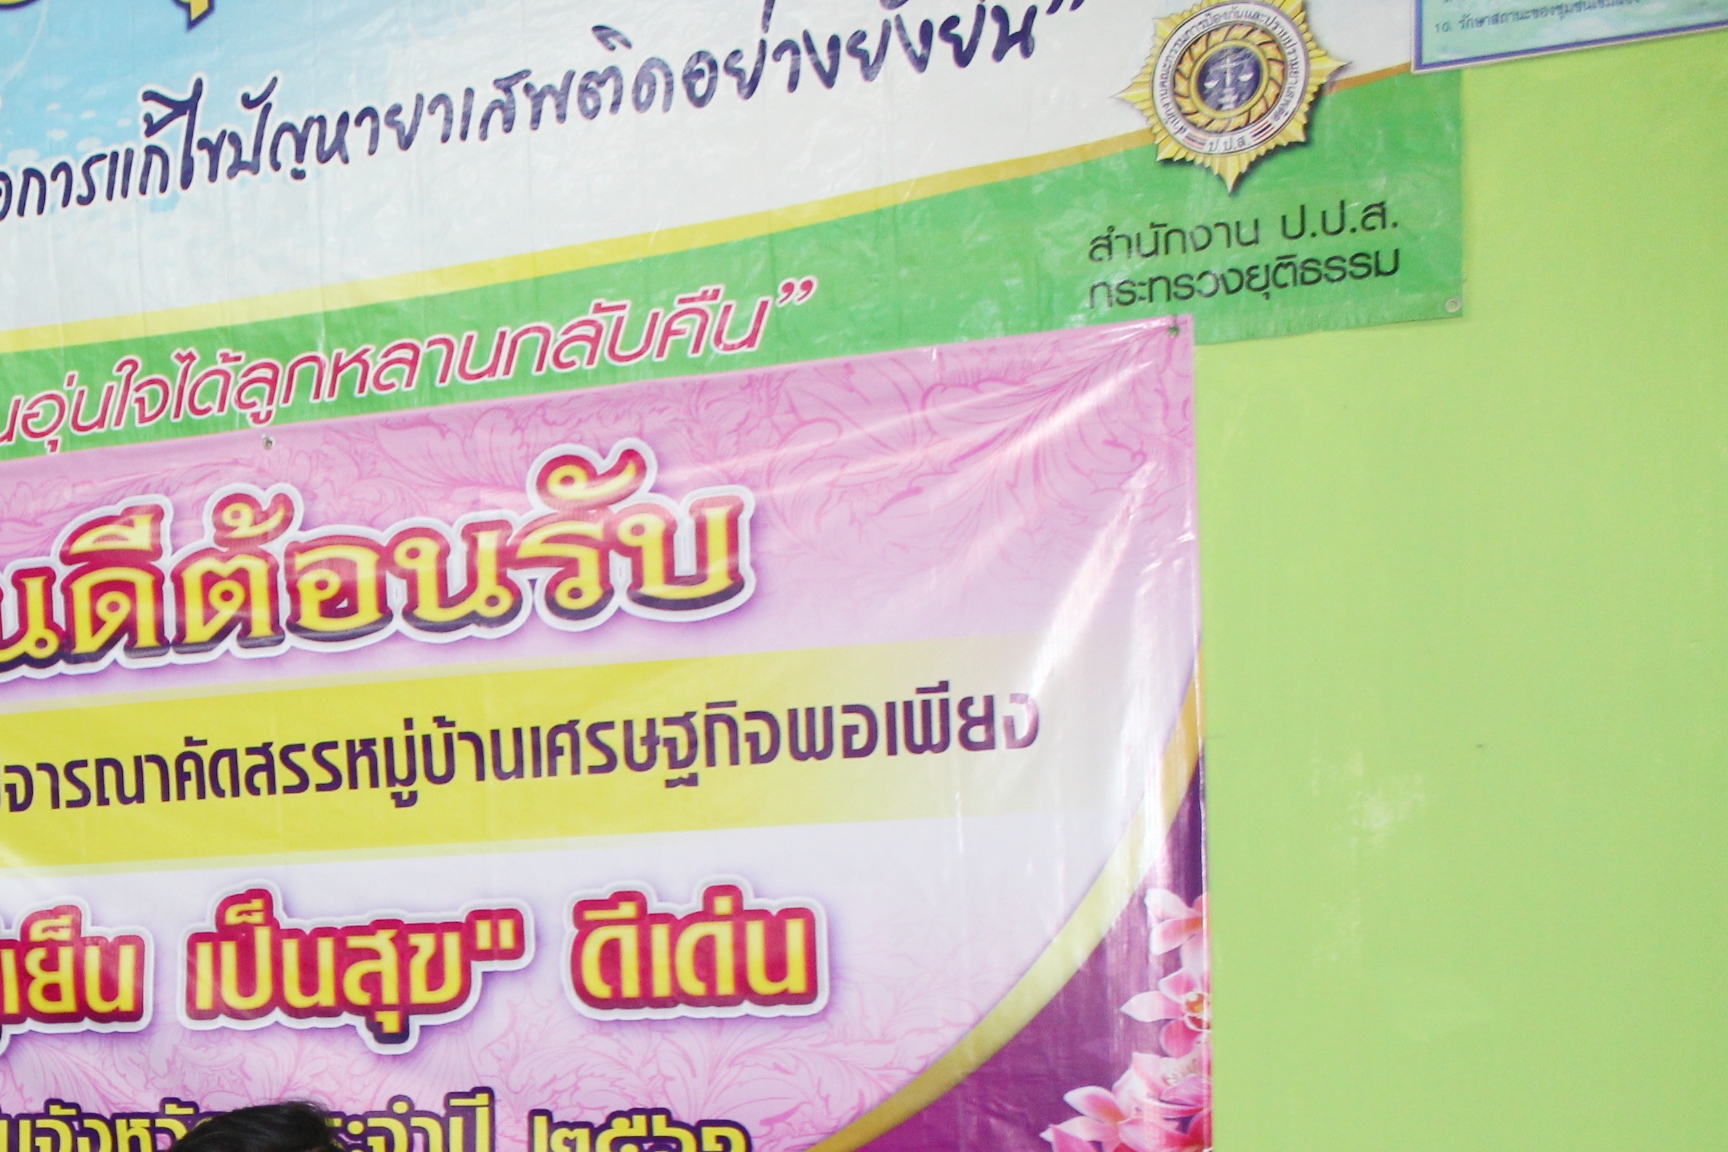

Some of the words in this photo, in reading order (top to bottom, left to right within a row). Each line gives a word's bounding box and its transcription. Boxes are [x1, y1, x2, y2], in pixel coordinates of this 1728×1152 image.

[1088, 216, 1260, 266] สำนักงาน
[1088, 248, 1402, 312] กระทรวงยุติธรรม
[572, 886, 820, 1008] ดีเด่น
